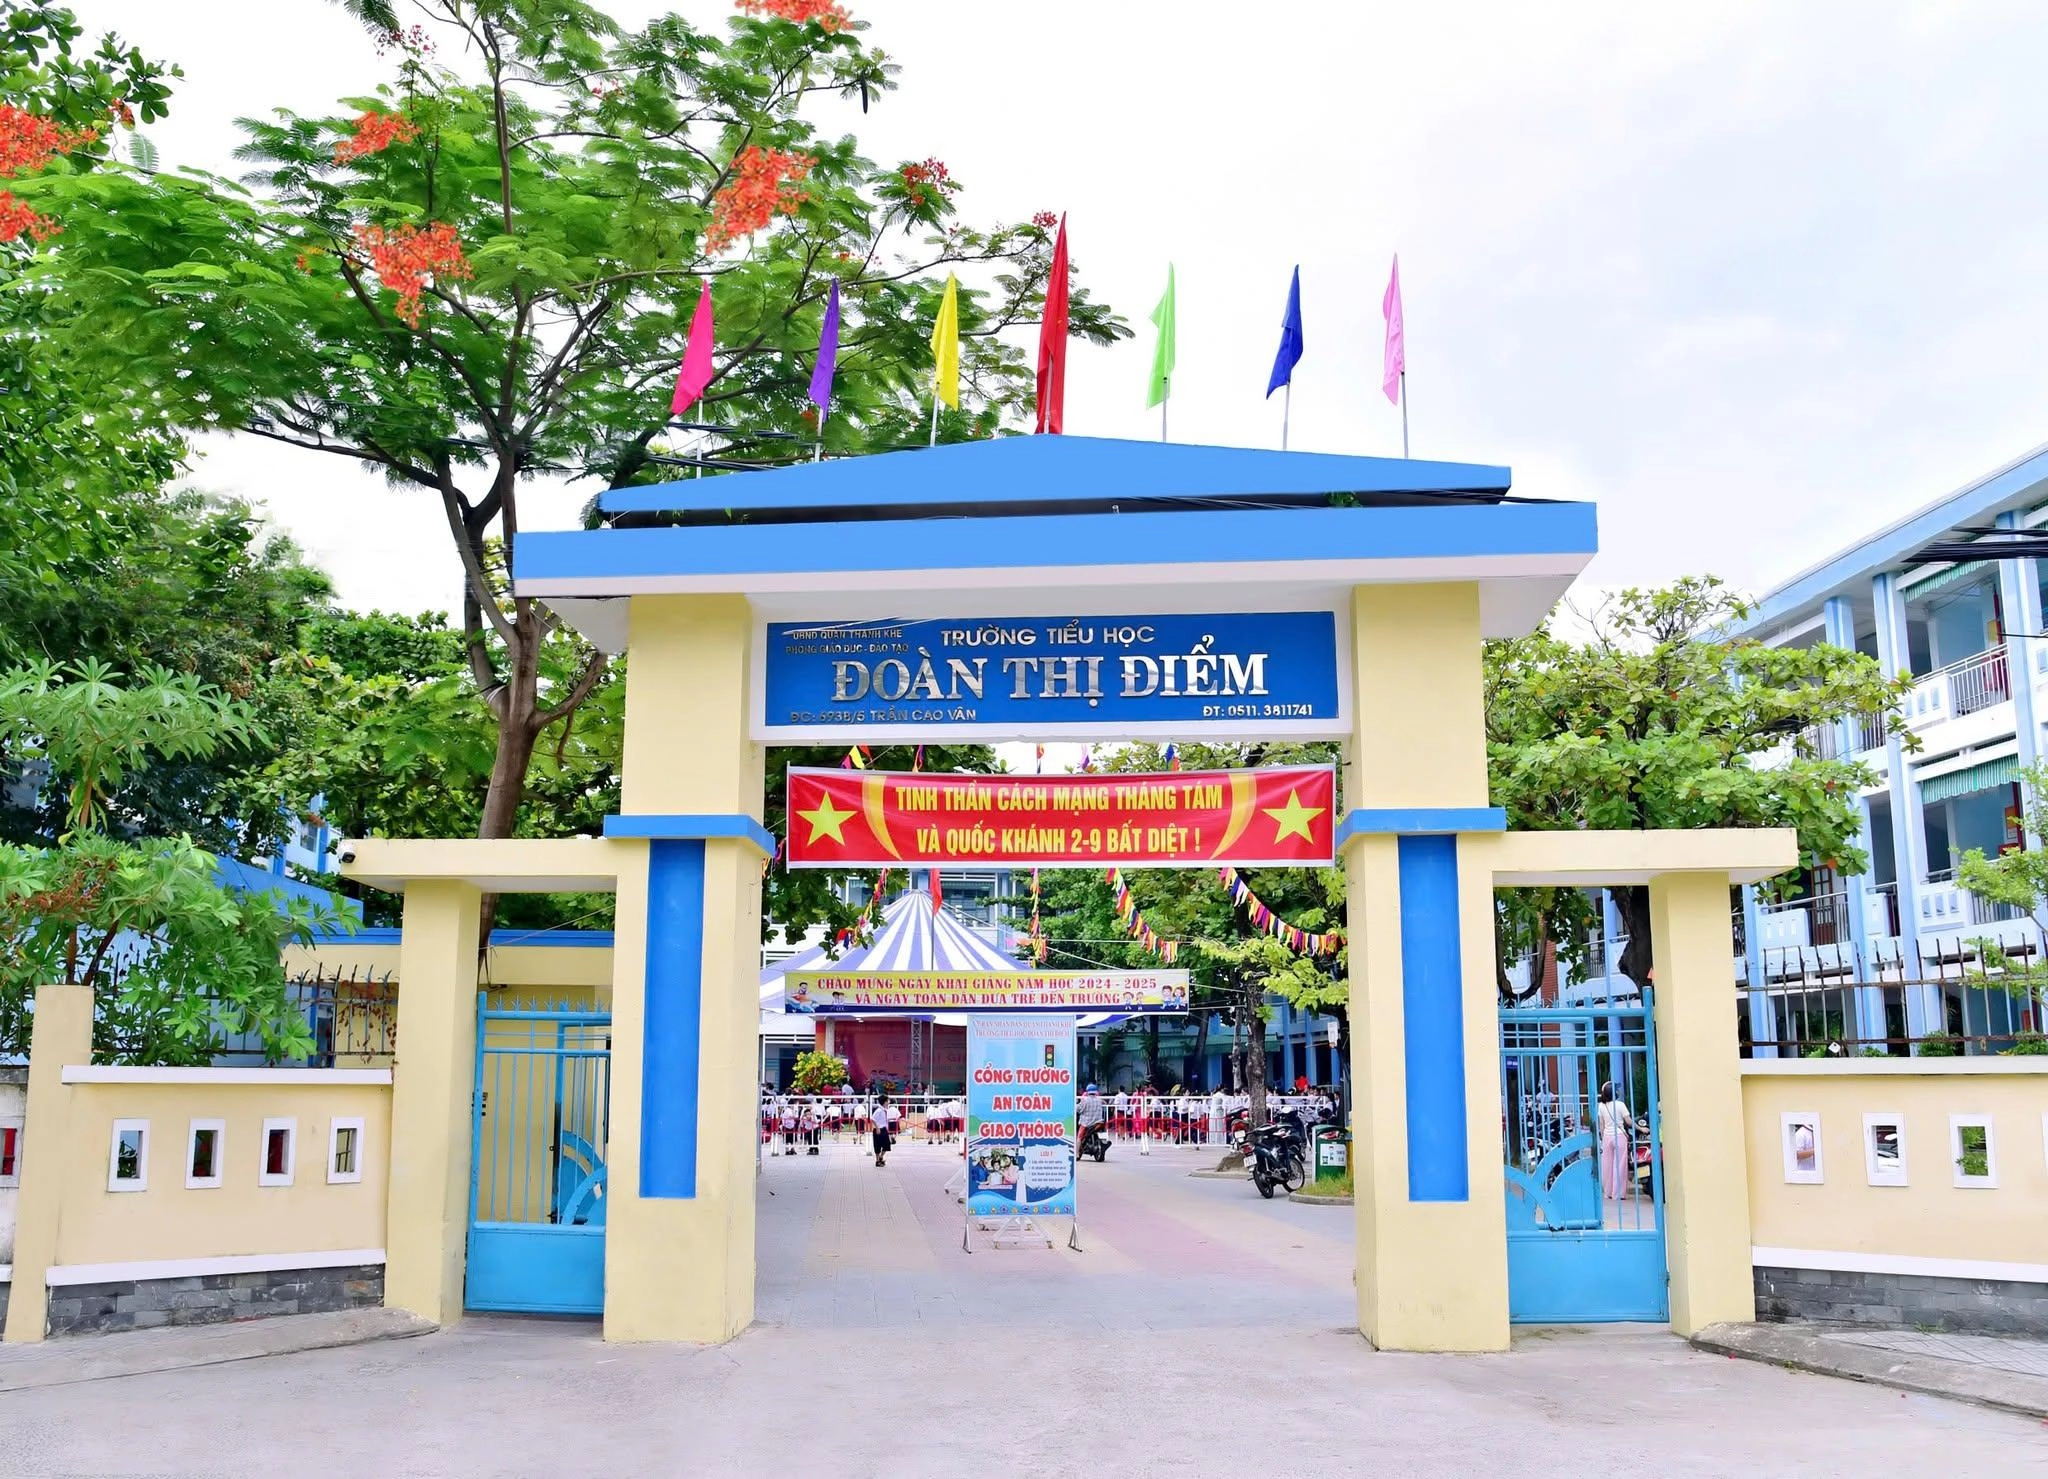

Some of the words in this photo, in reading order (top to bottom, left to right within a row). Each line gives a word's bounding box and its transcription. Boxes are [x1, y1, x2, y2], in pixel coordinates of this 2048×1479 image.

[793, 630, 817, 640] UBND
[849, 629, 881, 639] THANH
[941, 623, 1037, 646] TRƯỜNG
[1046, 618, 1094, 646] TIỂU
[1103, 626, 1155, 648] HỌC
[831, 646, 988, 701] ĐOÀN
[1002, 656, 1104, 707] THỊ
[1119, 634, 1269, 697] ĐIỂM
[870, 705, 908, 722] TRẦN
[912, 709, 943, 721] CAO
[947, 706, 977, 721] VÂN
[1203, 705, 1225, 717] ĐT:
[1228, 704, 1260, 717] 0511.
[1264, 704, 1313, 716] 3811741
[896, 787, 938, 811] TINH
[943, 780, 992, 811] THẦN
[997, 782, 1047, 811] CÁCH
[1053, 784, 1109, 816] MẠNG
[1115, 781, 1177, 810] THÁNG
[1182, 780, 1223, 810] TÁM
[916, 823, 941, 853] VÀ
[946, 820, 996, 857] QUỐC
[1001, 823, 1066, 853] KHÁNH
[1070, 828, 1101, 853] 2-9
[1106, 819, 1142, 853] BẤT
[1148, 823, 1188, 858] DIỆT
[818, 976, 851, 989] CHÀO
[856, 976, 893, 989] MỪNG
[898, 976, 931, 990] NGÀY
[937, 978, 967, 990] KHAI
[1079, 978, 1111, 989] 2024
[1124, 977, 1156, 989] 2025
[855, 992, 871, 1004] VÀ
[876, 991, 909, 1005] NGÀY
[951, 991, 977, 1004] DÂN
[1070, 991, 1120, 1004] TRƯỜNG
[974, 1062, 1013, 1083] CỔNG
[1016, 1066, 1070, 1083] TRƯỜNG
[993, 1096, 1012, 1110] AN
[1016, 1093, 1051, 1110] TOÀN
[980, 1123, 1015, 1138] GIAO
[1018, 1120, 1064, 1138] THÔNG
